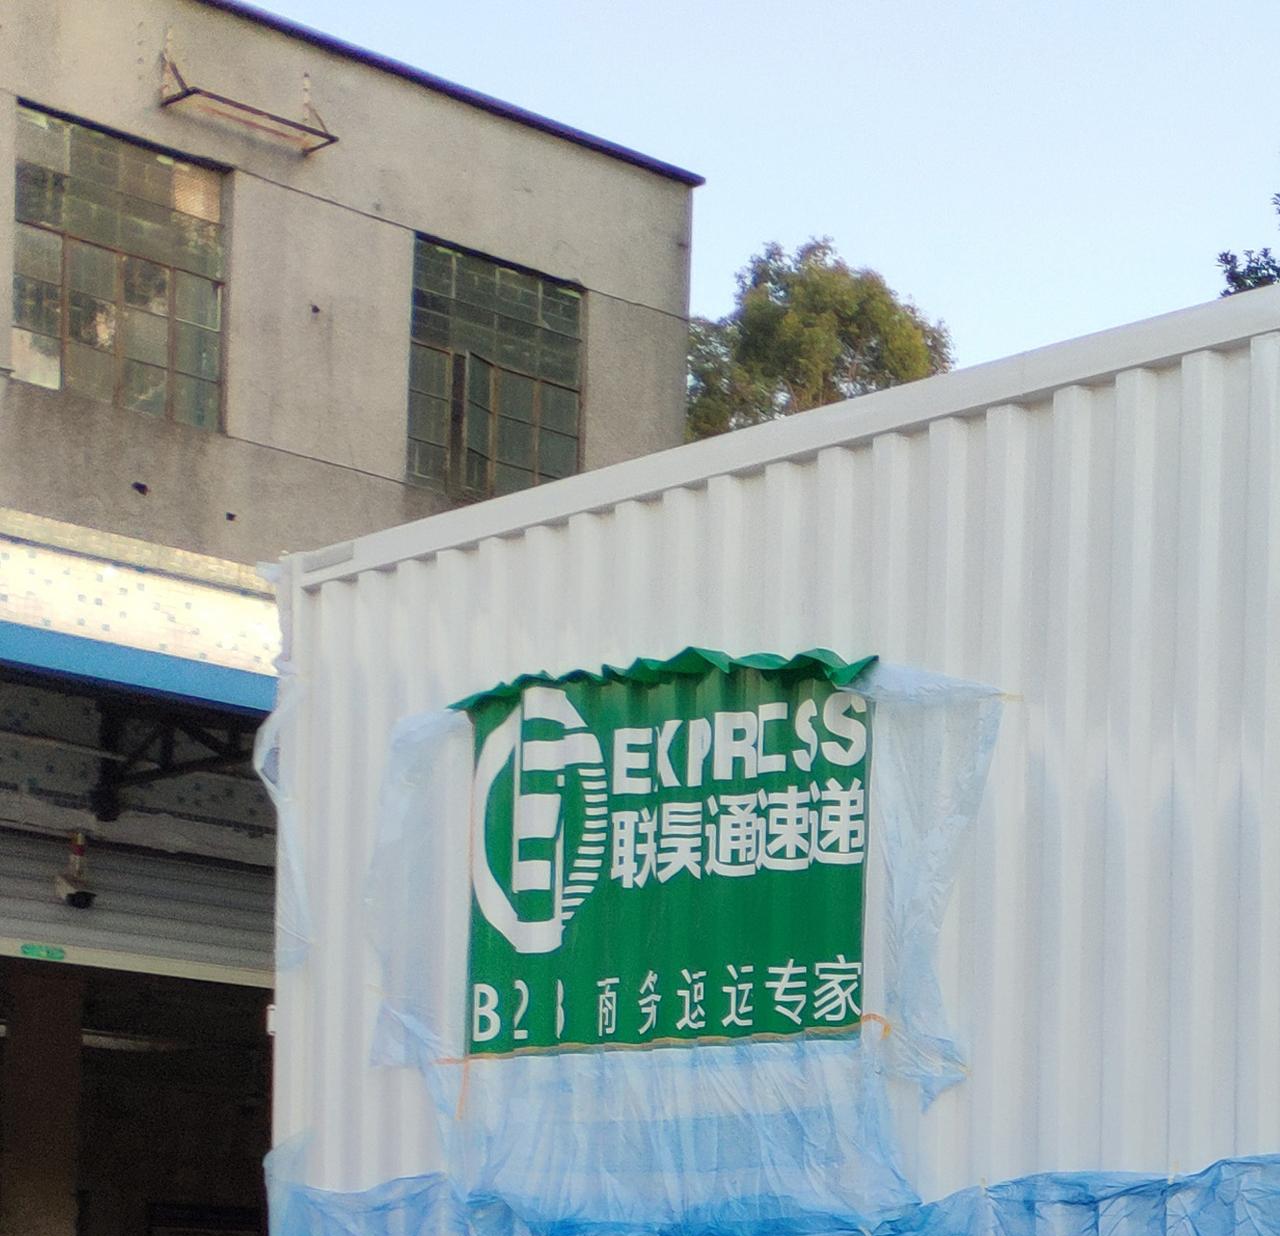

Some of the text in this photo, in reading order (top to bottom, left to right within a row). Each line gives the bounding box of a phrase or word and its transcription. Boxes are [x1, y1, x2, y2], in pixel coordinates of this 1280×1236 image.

[611, 777, 866, 889] 联昊通速递
